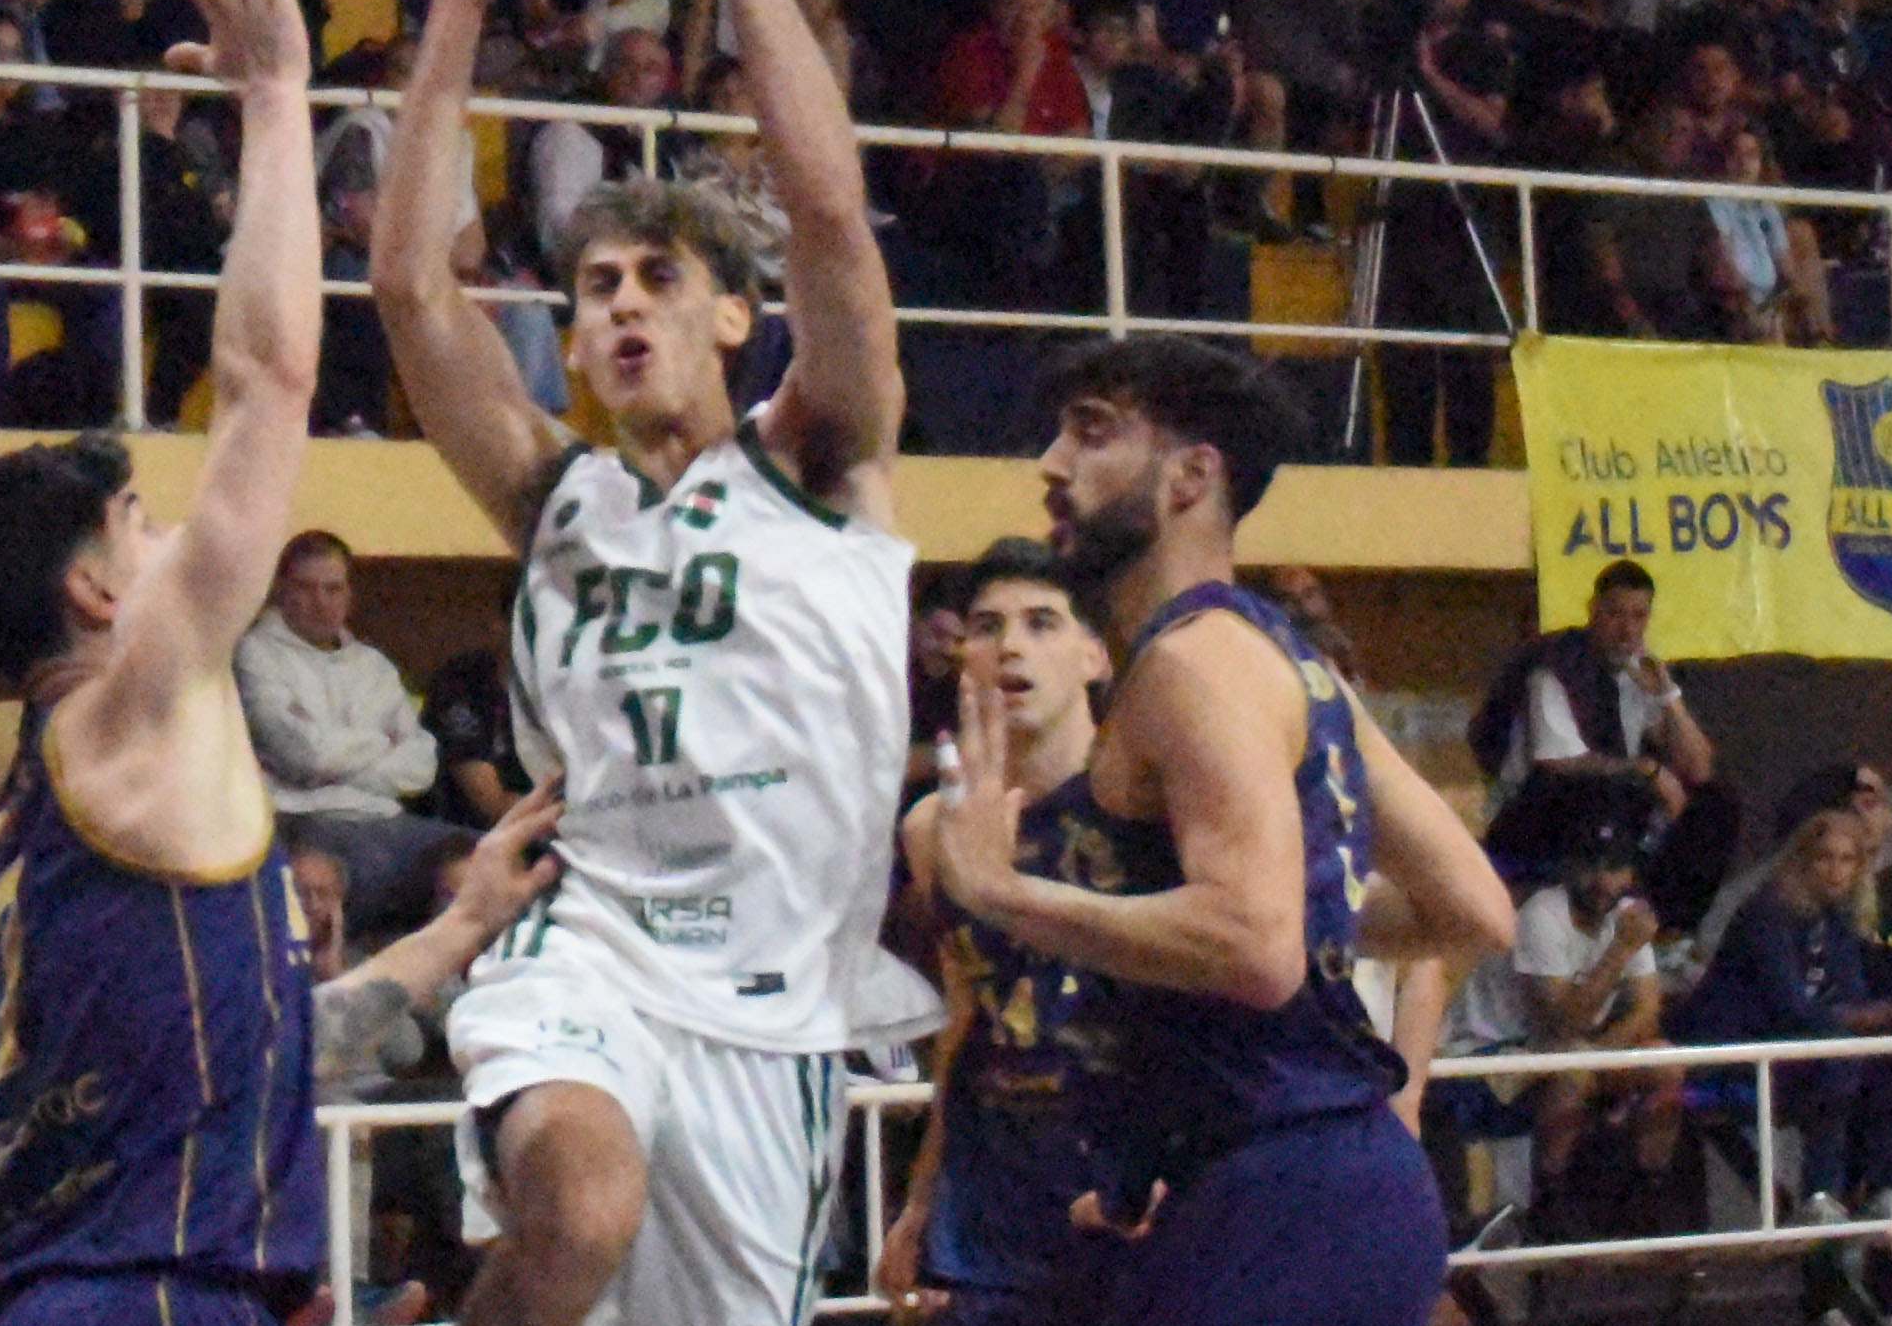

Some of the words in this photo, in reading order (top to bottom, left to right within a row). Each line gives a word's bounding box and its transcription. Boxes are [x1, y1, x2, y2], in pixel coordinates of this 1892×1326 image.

[1560, 436, 1638, 480] Club
[1563, 496, 1655, 555] ALL
[1668, 492, 1791, 553] BOYS
[558, 551, 740, 668] FCO
[619, 686, 682, 766] 17
